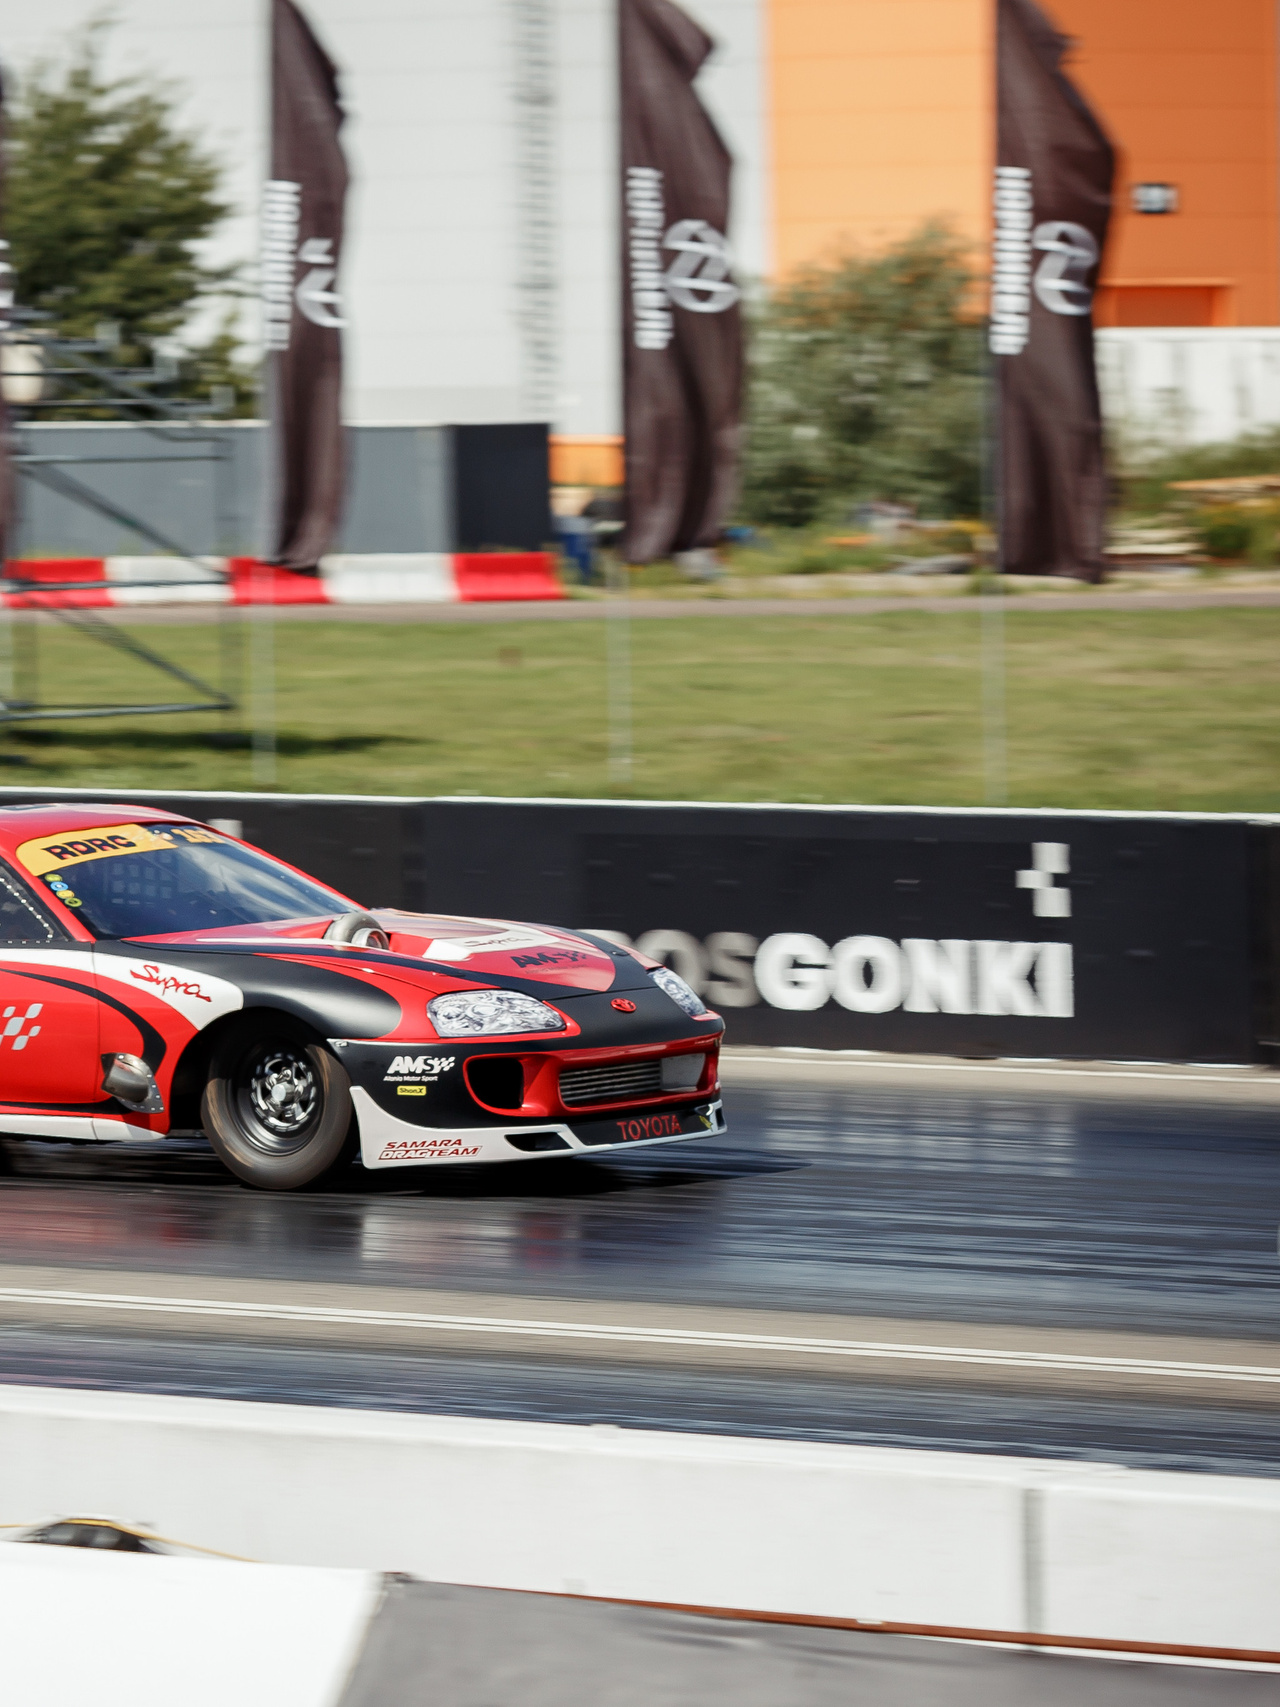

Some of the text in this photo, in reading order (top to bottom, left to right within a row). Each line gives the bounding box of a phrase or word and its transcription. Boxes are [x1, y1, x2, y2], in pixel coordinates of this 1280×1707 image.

[39, 834, 137, 860] RDRC
[130, 964, 212, 1002] Supra
[578, 929, 1074, 1017] OSGONKI
[386, 1055, 441, 1074] AMS
[616, 1114, 682, 1141] TOYOTA
[385, 1138, 462, 1149] SAMARA
